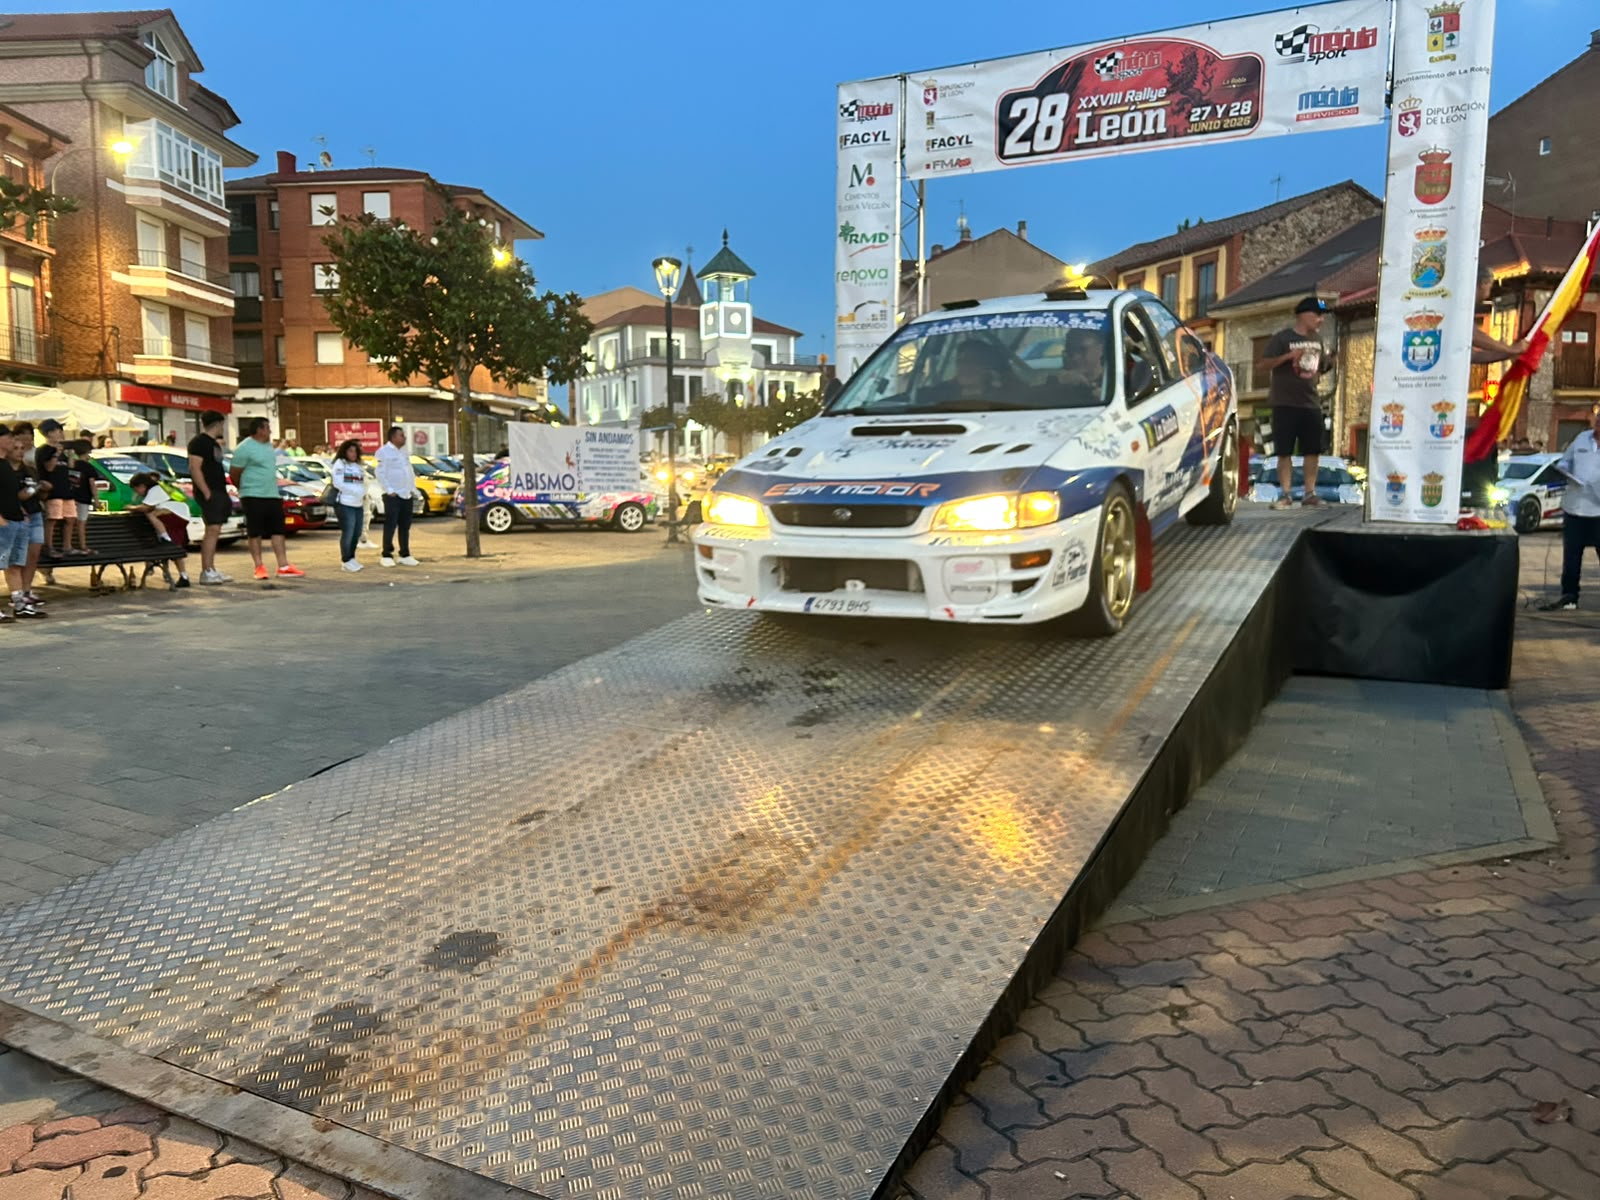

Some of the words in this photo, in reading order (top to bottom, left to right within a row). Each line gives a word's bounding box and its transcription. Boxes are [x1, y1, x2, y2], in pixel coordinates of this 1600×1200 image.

[1307, 47, 1347, 65] sport
[1447, 69, 1457, 77] de
[1458, 67, 1468, 75] La
[1077, 92, 1123, 110] XXVIII
[1125, 87, 1168, 103] Rallye
[1190, 105, 1211, 122] 27
[1216, 104, 1227, 118] Y
[1229, 100, 1252, 117] 28
[1298, 108, 1358, 120] SERVICIOS
[1426, 101, 1486, 116] DIPUTACIÓN
[1003, 92, 1069, 156] 28
[1074, 105, 1168, 144] León
[1187, 119, 1221, 133] JUNIO
[1426, 117, 1438, 125] DE
[844, 130, 891, 146] FACYL
[931, 135, 973, 149] FACYL
[849, 232, 889, 244] RMD
[836, 267, 888, 284] renova
[585, 431, 597, 443] SIN
[514, 472, 575, 491] ABISMO
[832, 481, 941, 498] MOTOR
[814, 599, 845, 611] 4793
